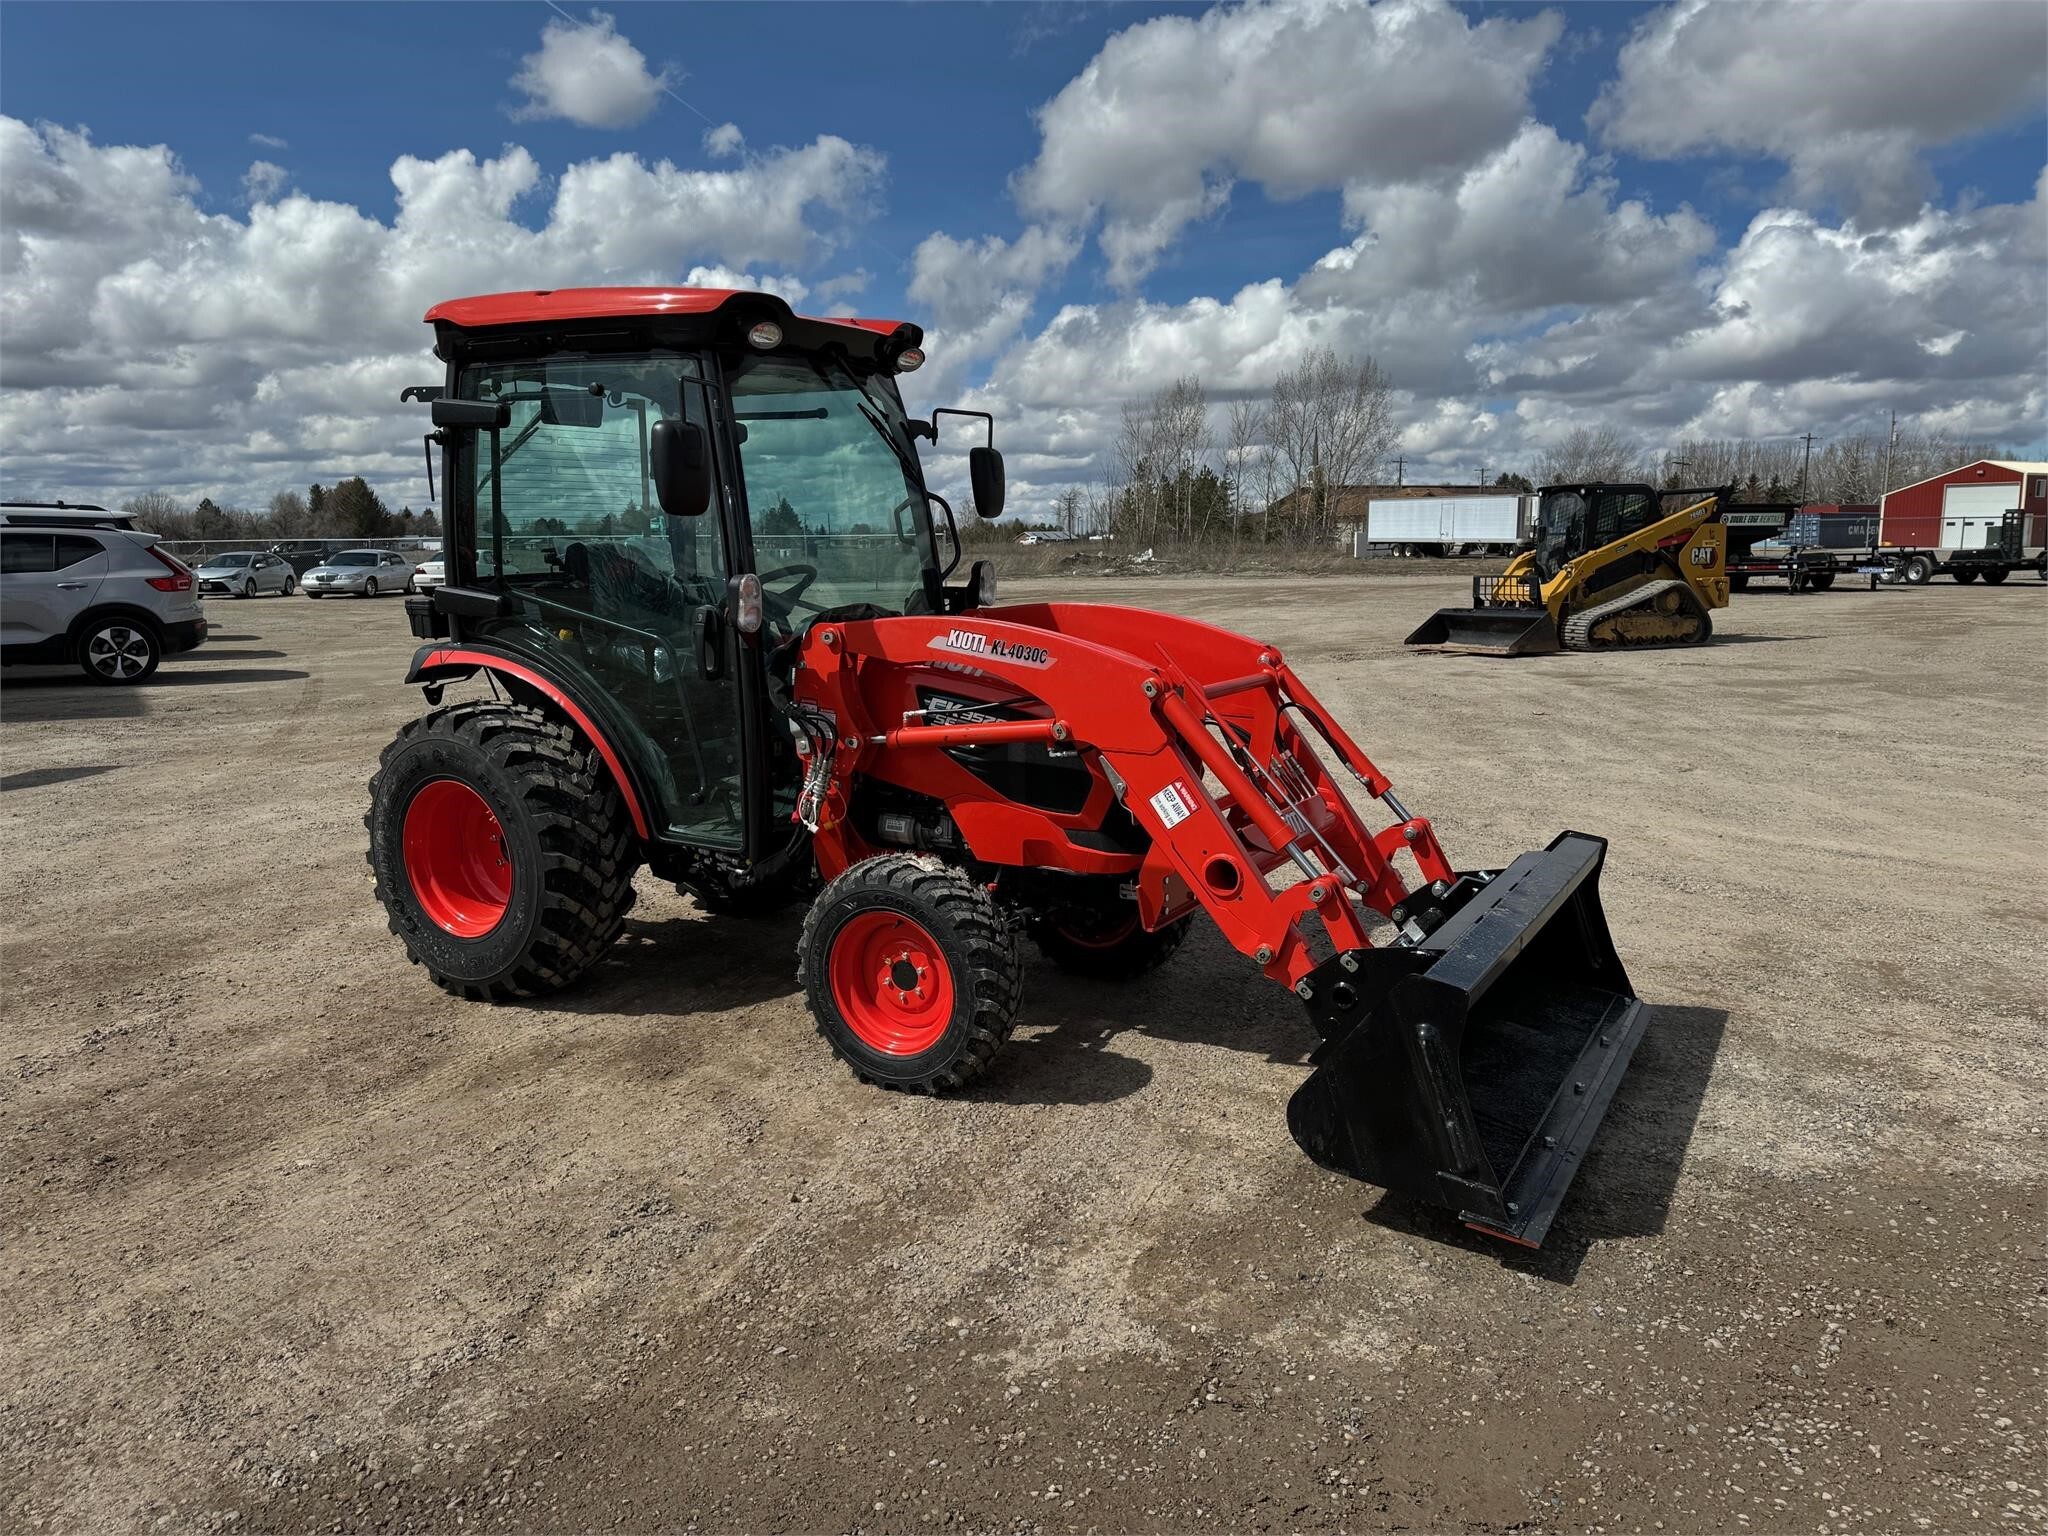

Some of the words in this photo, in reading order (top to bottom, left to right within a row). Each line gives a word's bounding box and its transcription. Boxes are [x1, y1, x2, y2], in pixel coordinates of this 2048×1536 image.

[1848, 525, 1865, 536] CMA
[1691, 547, 1713, 565] CAT
[947, 629, 986, 653] KIOTI
[991, 640, 1048, 664] KL4030C
[1162, 788, 1176, 803] KEEP
[1171, 802, 1186, 819] AWAY
